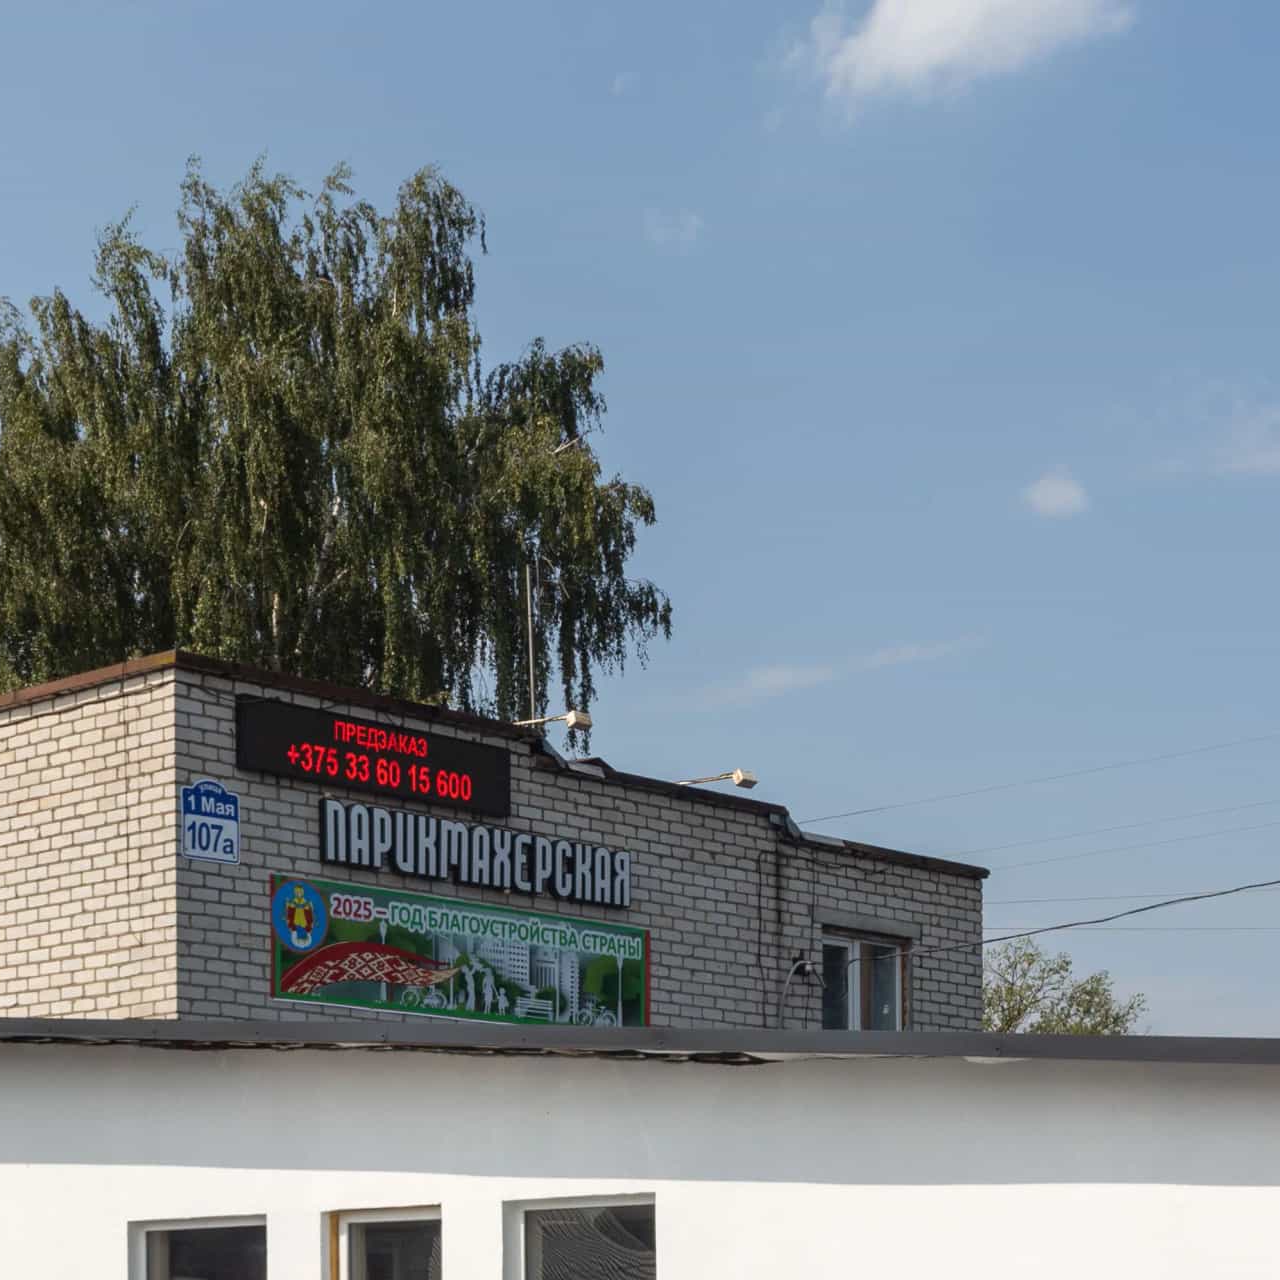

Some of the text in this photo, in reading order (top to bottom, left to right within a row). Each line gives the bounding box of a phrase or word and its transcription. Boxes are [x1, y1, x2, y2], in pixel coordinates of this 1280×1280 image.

[334, 720, 428, 758] ПРЕДЗАКАЗ
[287, 743, 472, 801] +375 33 60 15 600
[187, 794, 235, 817] 1 Мая
[187, 820, 234, 854] 107а
[325, 799, 631, 907] ПАРИКМАХЕРСКАЯ
[331, 897, 373, 919] 2025
[391, 902, 424, 929] ГОД
[428, 910, 579, 950] БЛАГОУСТРОЙСТВА
[582, 931, 643, 960] СТРАНЫ
